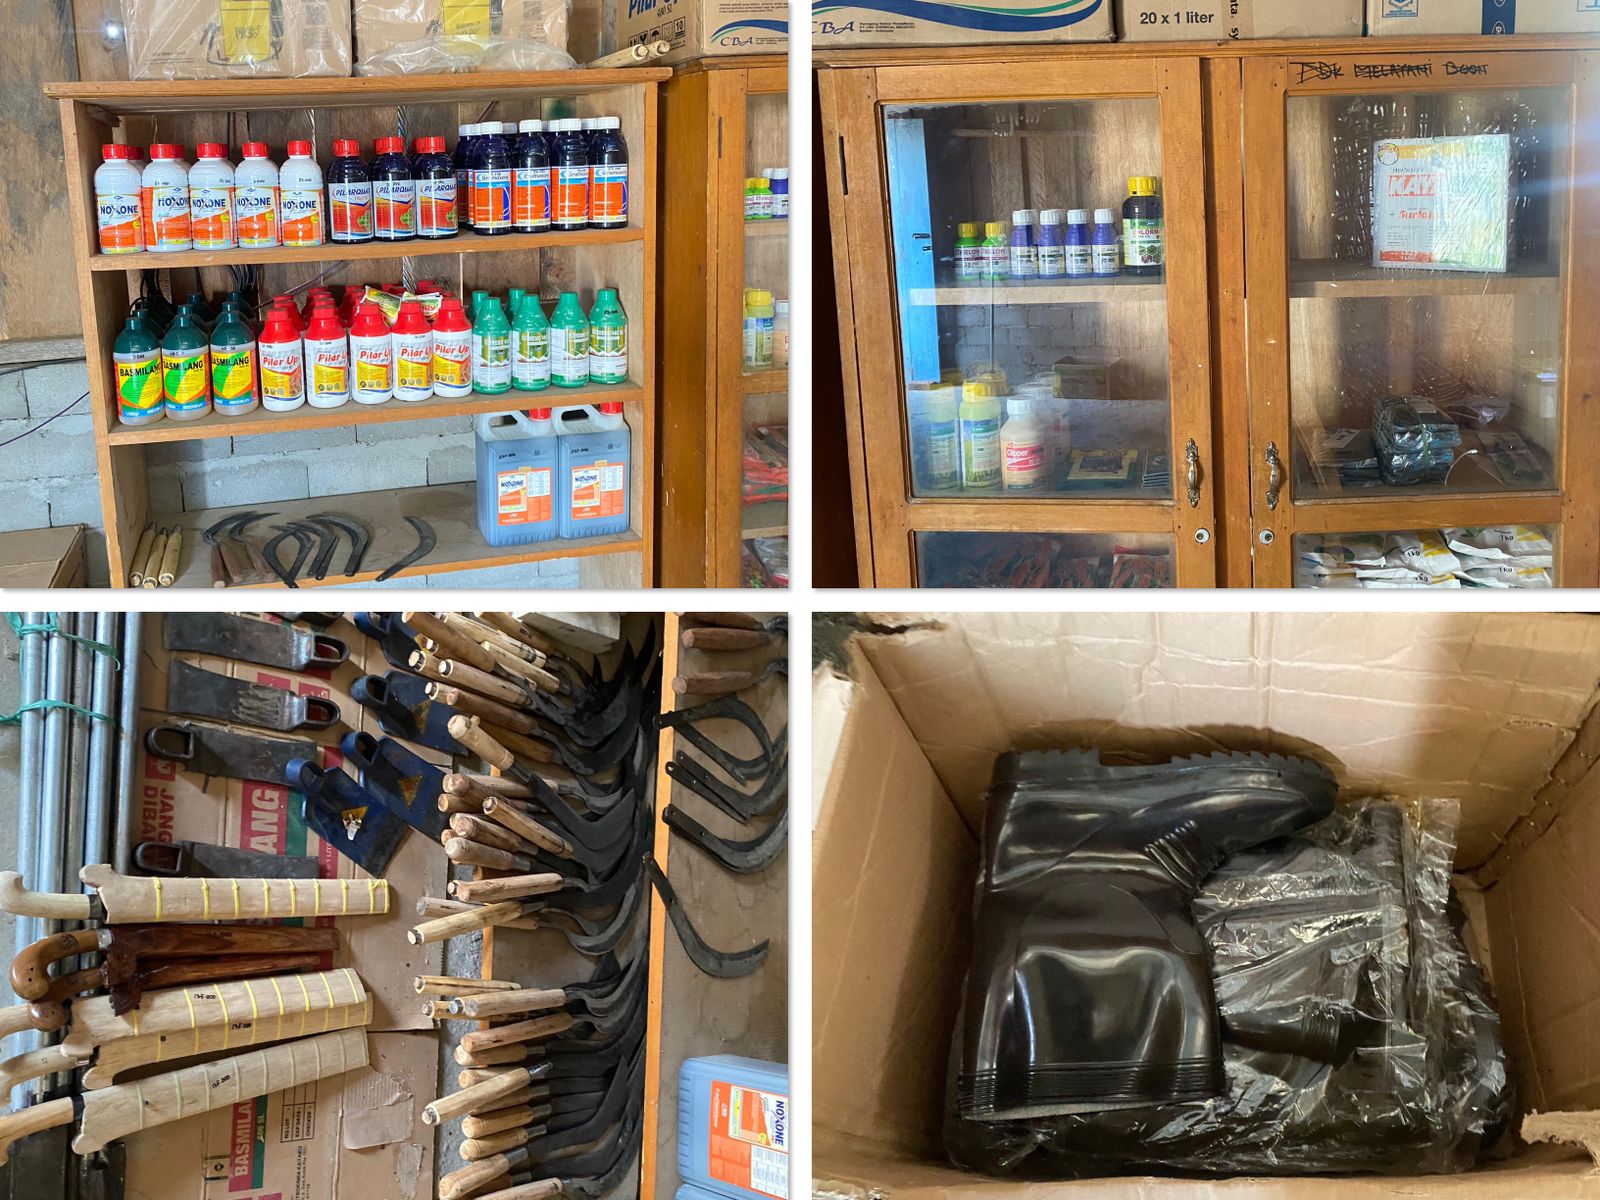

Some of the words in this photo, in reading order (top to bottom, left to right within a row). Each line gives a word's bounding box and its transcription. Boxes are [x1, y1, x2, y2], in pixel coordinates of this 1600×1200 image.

[1139, 12, 1157, 25] 20
[1160, 15, 1170, 24] x
[1173, 12, 1181, 24] 1
[1186, 11, 1215, 24] liter
[192, 198, 226, 209] NOXONE
[236, 197, 271, 207] NOXONE
[282, 200, 316, 210] NOXONE
[100, 205, 138, 216] NOXONE
[400, 348, 423, 357] Pilar
[434, 344, 455, 354] Pilar
[458, 344, 469, 354] Up
[318, 353, 340, 363] Pilar
[359, 350, 382, 359] Pilar
[262, 356, 283, 365] Pilar
[286, 355, 298, 366] Up
[773, 1100, 786, 1147] NOXONE
